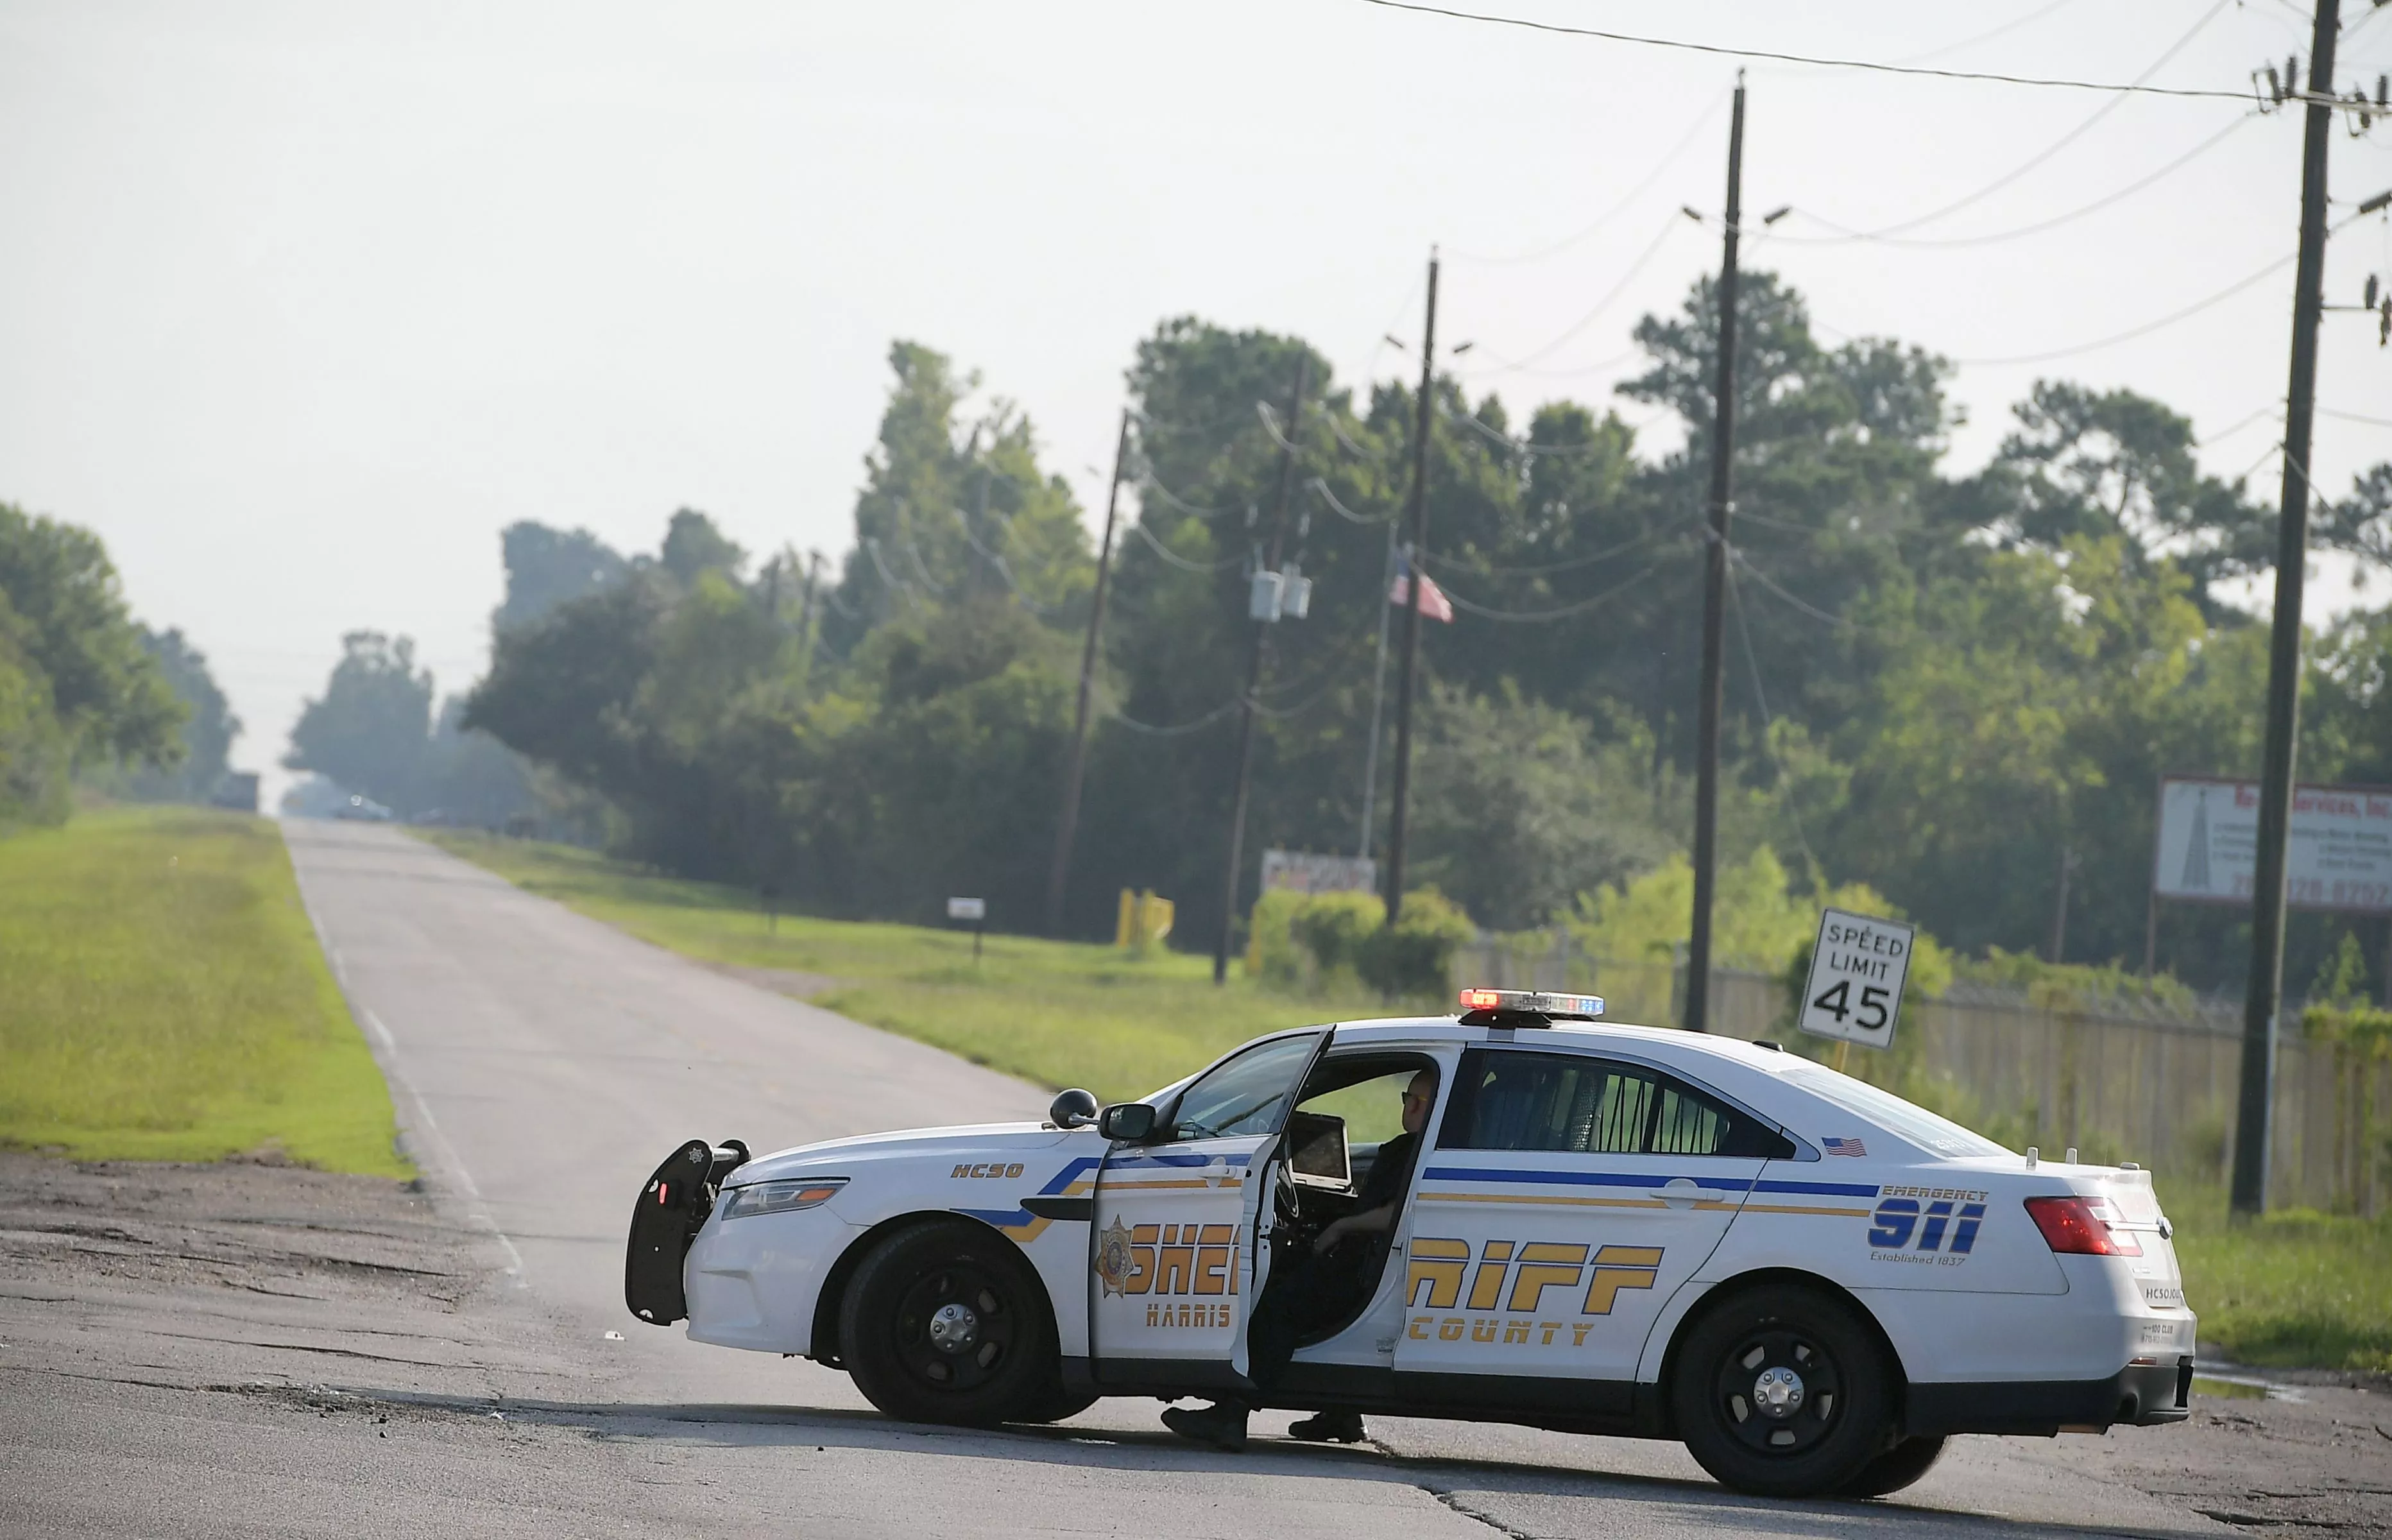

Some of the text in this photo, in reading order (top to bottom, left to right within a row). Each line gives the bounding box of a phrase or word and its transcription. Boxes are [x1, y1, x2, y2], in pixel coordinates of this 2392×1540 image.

[1827, 924, 1904, 958] SPEED
[1830, 951, 1890, 982] LIMIT
[1813, 979, 1890, 1031] 45
[950, 1163, 1024, 1178] HCSO
[1882, 1185, 1988, 1202] EMERGENCY
[1867, 1197, 1988, 1254] 911
[1125, 1223, 1240, 1295] SHE
[1407, 1237, 1666, 1315] RIFF
[1870, 1251, 1965, 1267] Established 1837
[1146, 1304, 1231, 1328] HARRIS
[1408, 1316, 1595, 1346] COUNTY
